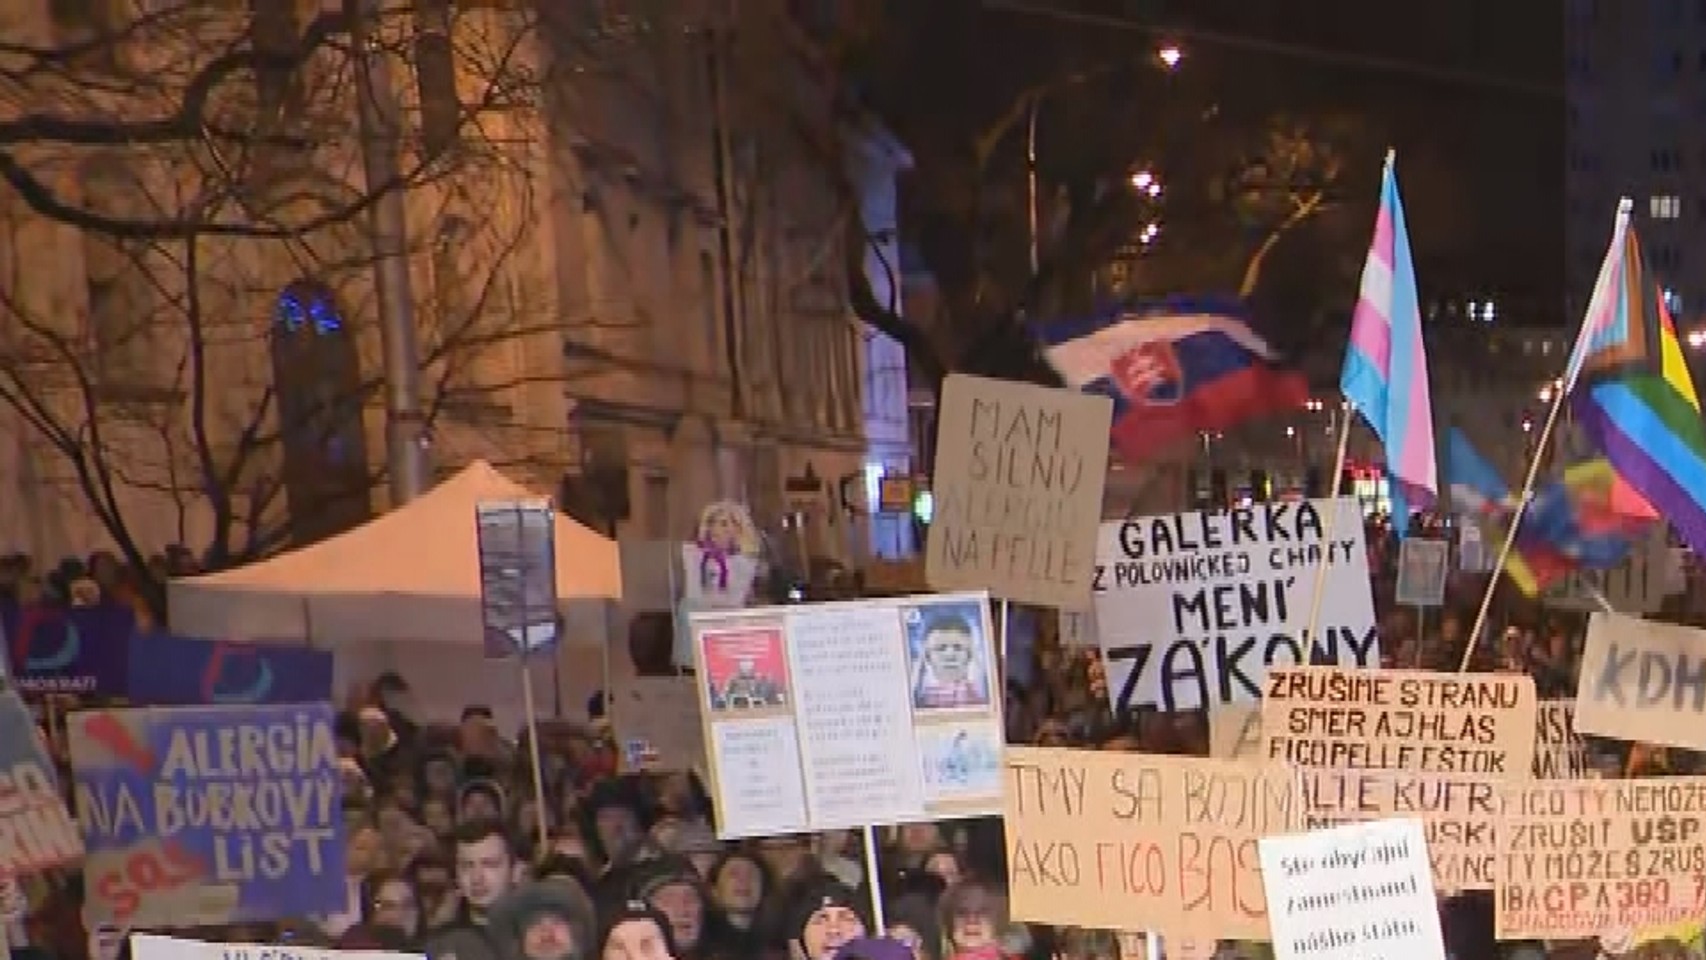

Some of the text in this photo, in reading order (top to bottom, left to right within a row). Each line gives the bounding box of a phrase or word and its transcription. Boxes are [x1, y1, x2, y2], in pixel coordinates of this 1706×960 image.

[1093, 565, 1108, 592] Z
[1268, 671, 1519, 710] ZRUŠIME STRANU
[1288, 707, 1367, 738] SMER
[1418, 712, 1496, 745] HLAS
[1268, 736, 1327, 768] FICO
[75, 781, 145, 838] NA
[1111, 766, 1163, 825] SA
[1577, 787, 1608, 816] TY
[1011, 838, 1081, 888] AKO
[1096, 841, 1166, 897] FICO
[1503, 852, 1536, 883] TY
